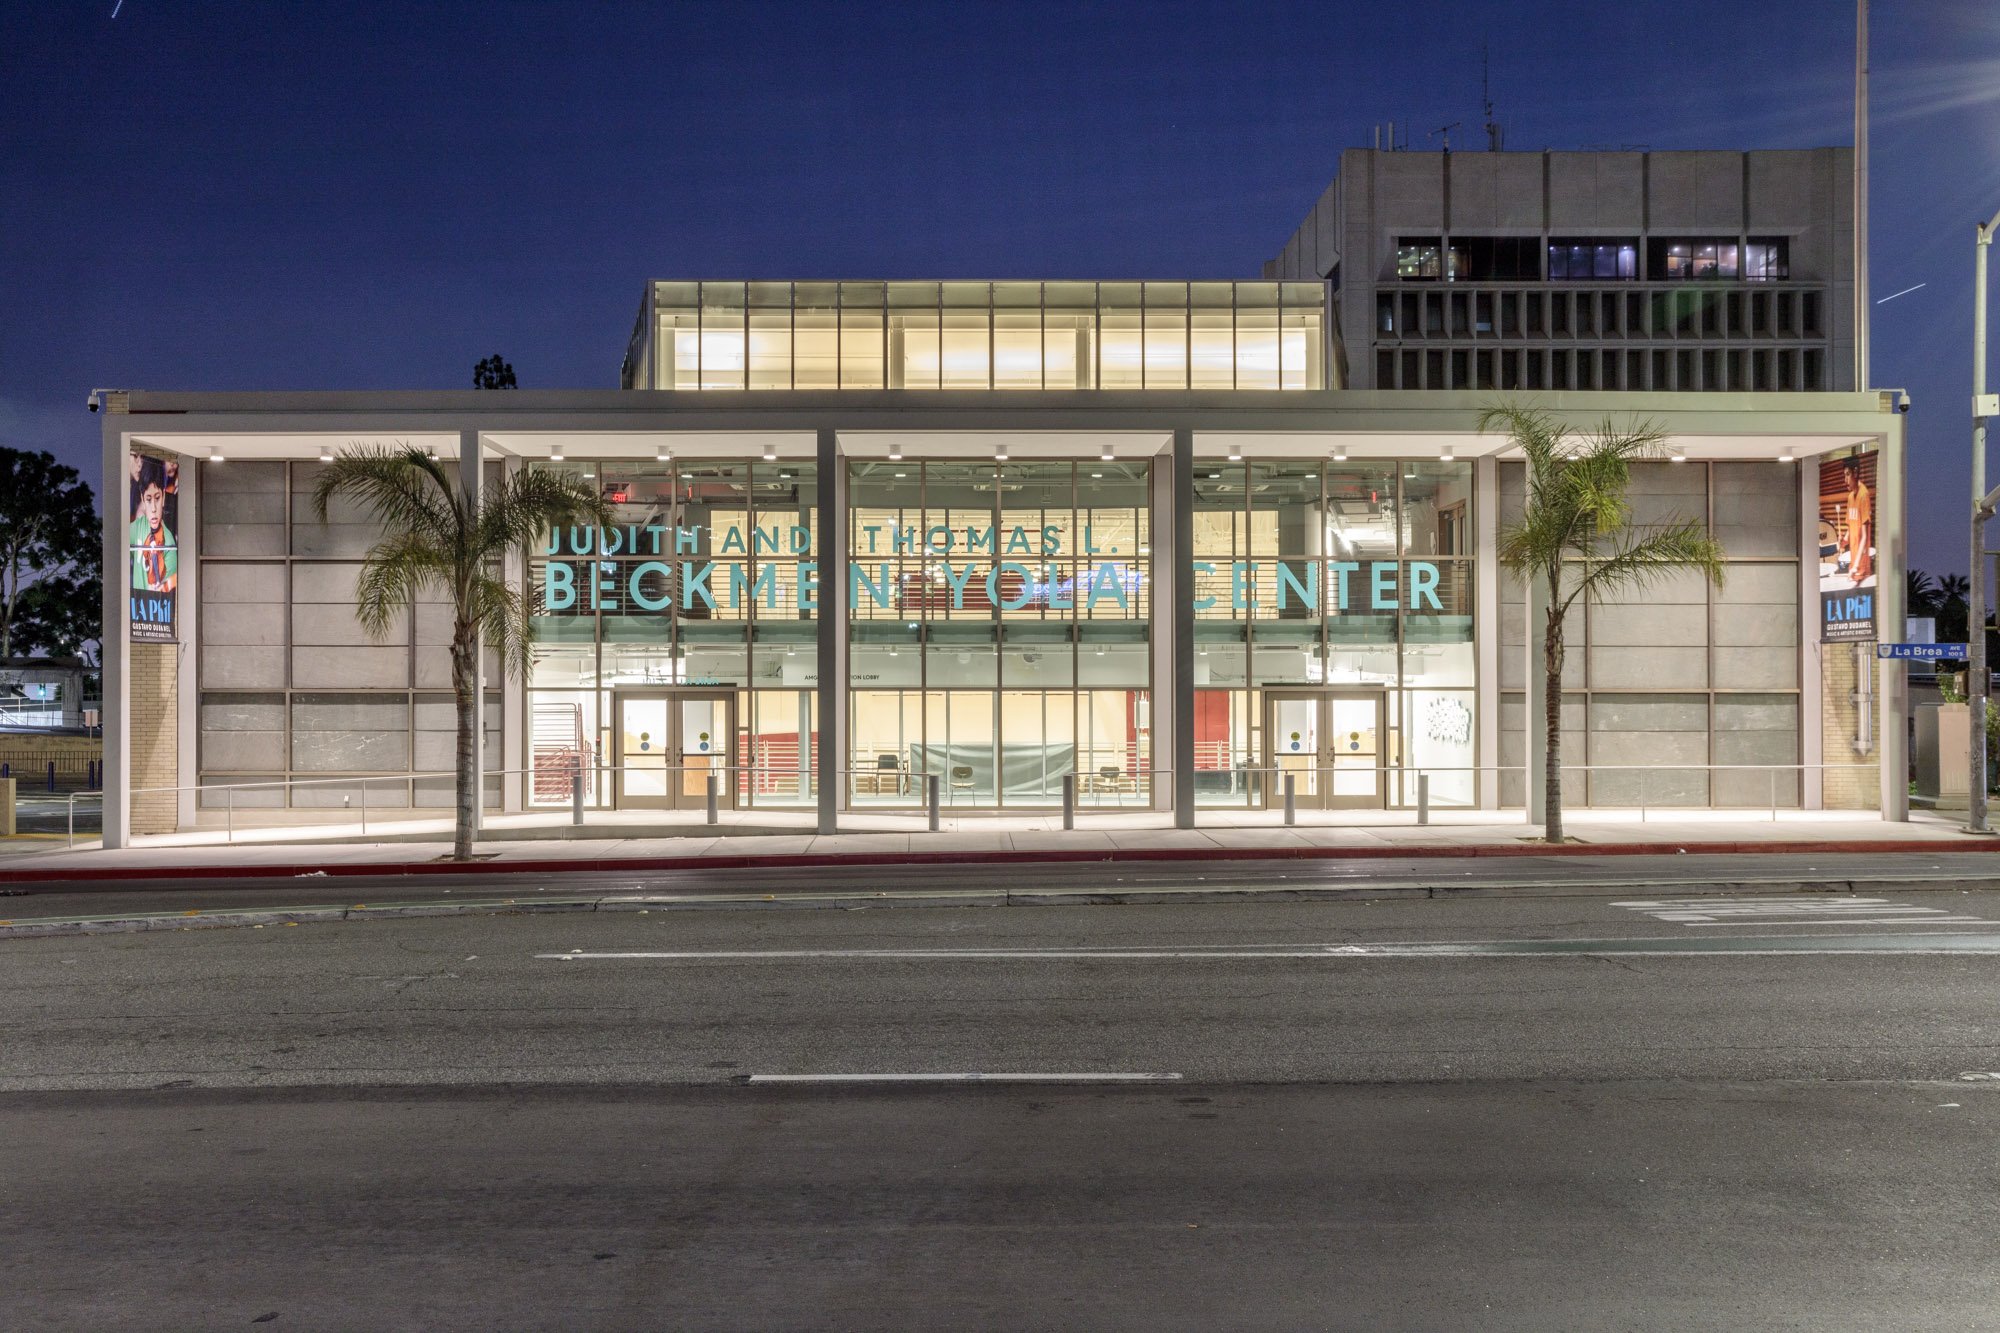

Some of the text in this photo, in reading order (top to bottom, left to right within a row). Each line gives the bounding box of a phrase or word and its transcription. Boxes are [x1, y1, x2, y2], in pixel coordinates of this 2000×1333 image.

[544, 525, 1118, 554] JUDITH AND THOMAS L.
[545, 561, 889, 610] BECKMEN
[939, 561, 1129, 610] YOLA
[131, 597, 171, 623] LA Phil
[1827, 595, 1872, 621] LA Phil
[1895, 646, 1943, 656] La Brea
